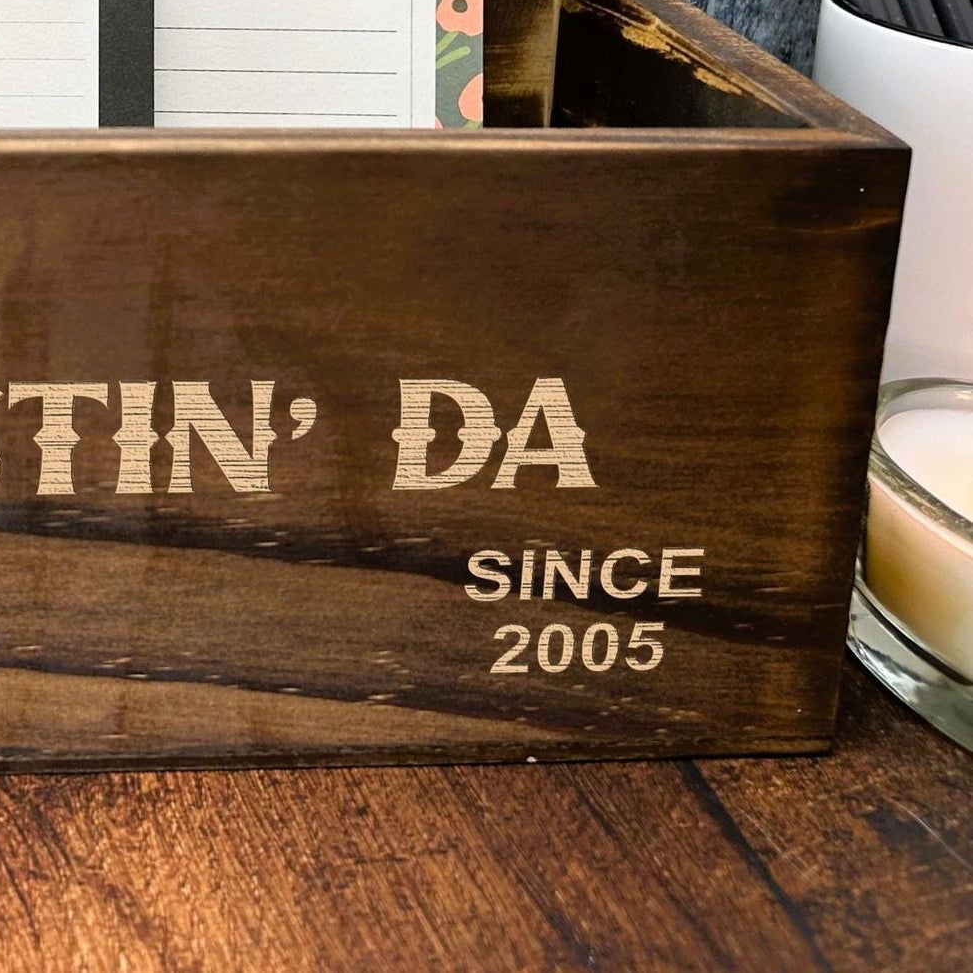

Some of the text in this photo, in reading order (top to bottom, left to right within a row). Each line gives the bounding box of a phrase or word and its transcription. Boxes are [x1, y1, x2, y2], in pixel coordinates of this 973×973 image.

[391, 377, 597, 490] DA
[464, 548, 705, 602] SINCE
[489, 622, 664, 674] 2005
